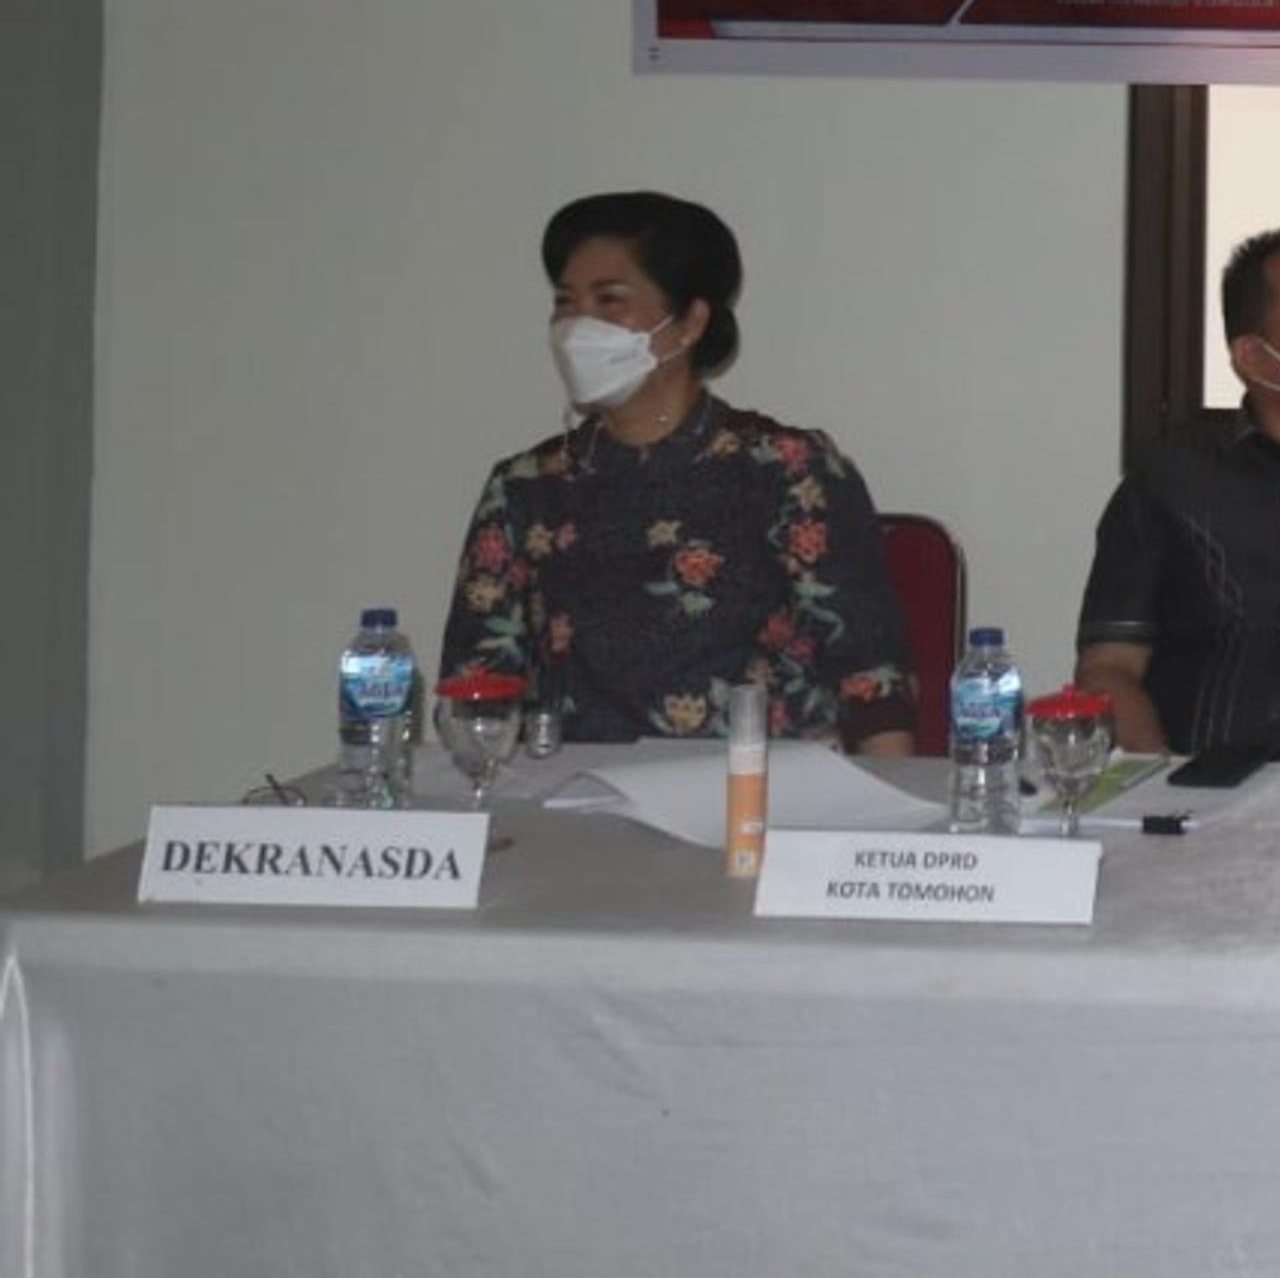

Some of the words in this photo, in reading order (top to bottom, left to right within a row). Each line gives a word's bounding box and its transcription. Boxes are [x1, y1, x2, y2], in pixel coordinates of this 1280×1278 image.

[162, 840, 462, 881] DEKRANASDA
[855, 851, 917, 870] KETUA
[923, 852, 977, 871] DPRD
[826, 881, 880, 900] KOTA
[888, 883, 995, 903] TOMOHON
